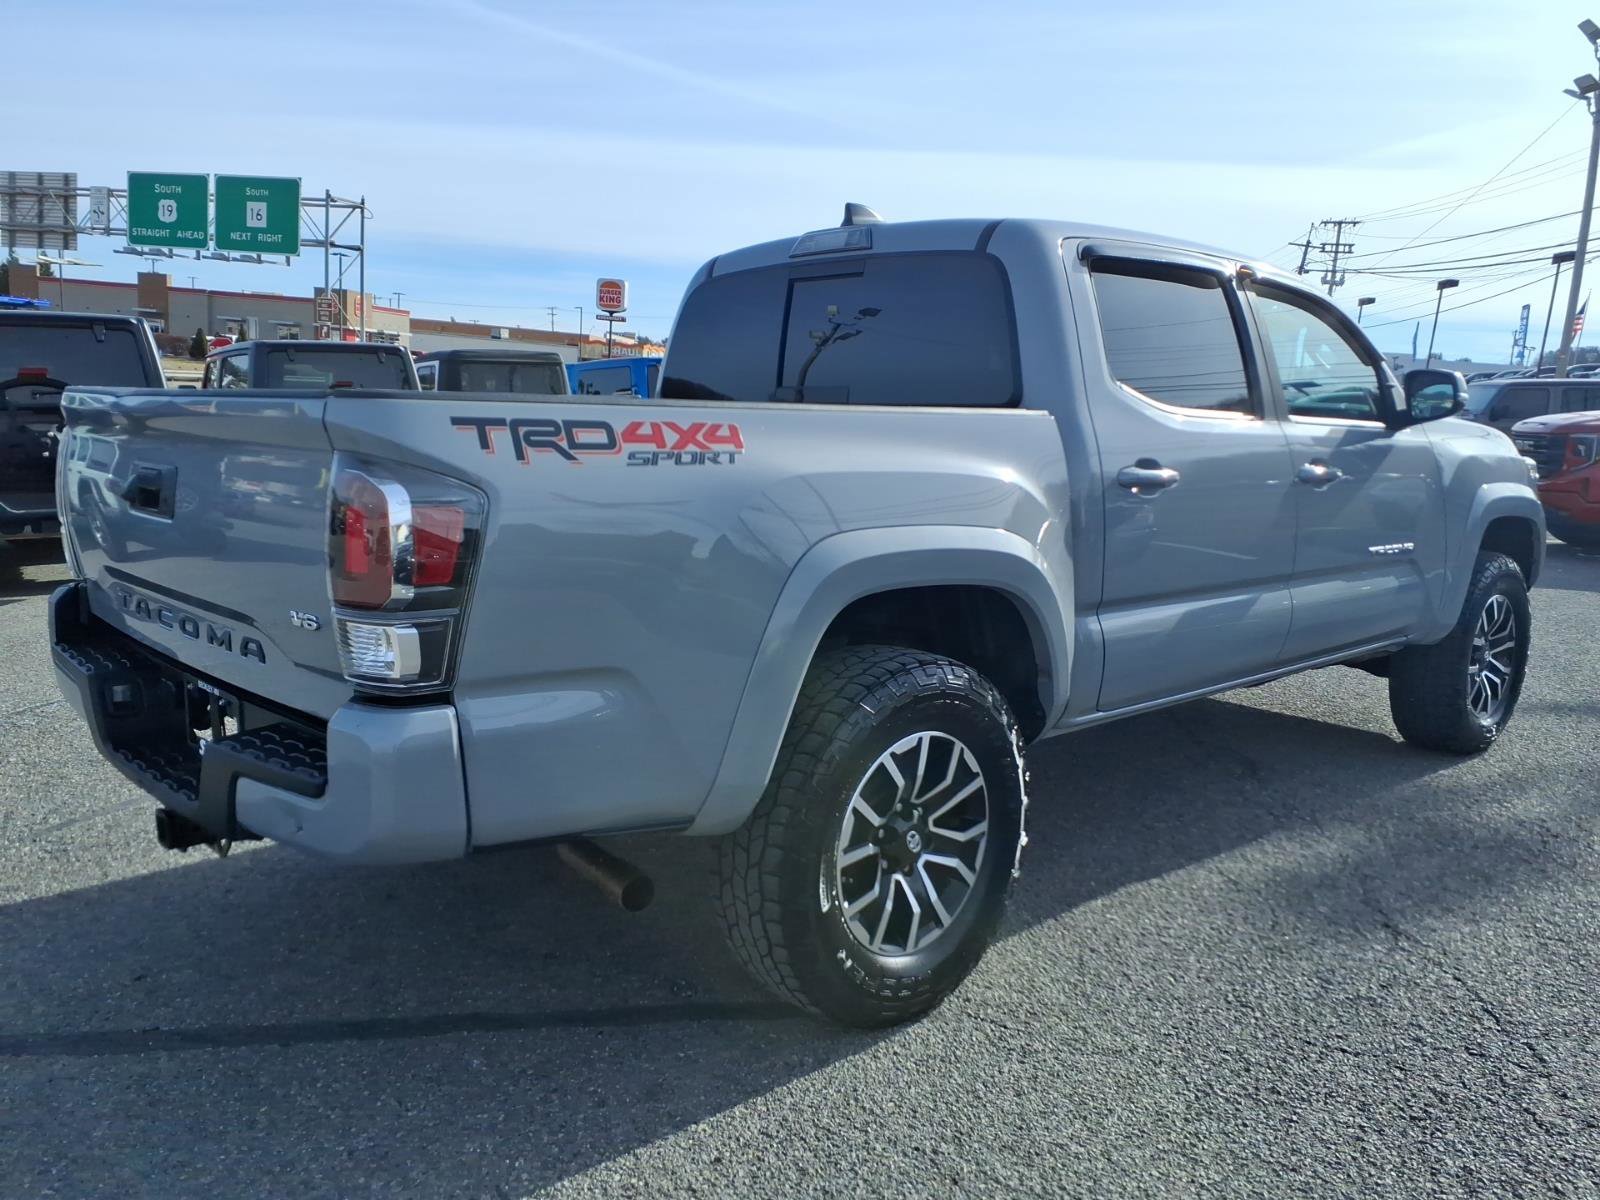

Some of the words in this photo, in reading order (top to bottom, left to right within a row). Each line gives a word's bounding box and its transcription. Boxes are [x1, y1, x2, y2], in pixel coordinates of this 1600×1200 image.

[154, 183, 182, 194] SOUTH
[246, 187, 269, 196] SOUTH
[161, 204, 174, 218] 19
[250, 207, 264, 221] 16
[132, 227, 170, 237] STRAIGHT
[176, 229, 205, 239] AHEAD
[230, 232, 251, 241] NEXT
[257, 233, 283, 243] RIGHT
[599, 295, 622, 304] KING
[450, 416, 620, 464] TRD
[626, 450, 744, 467] SPORT
[117, 590, 267, 665] TACOMA
[289, 609, 321, 632] V6
